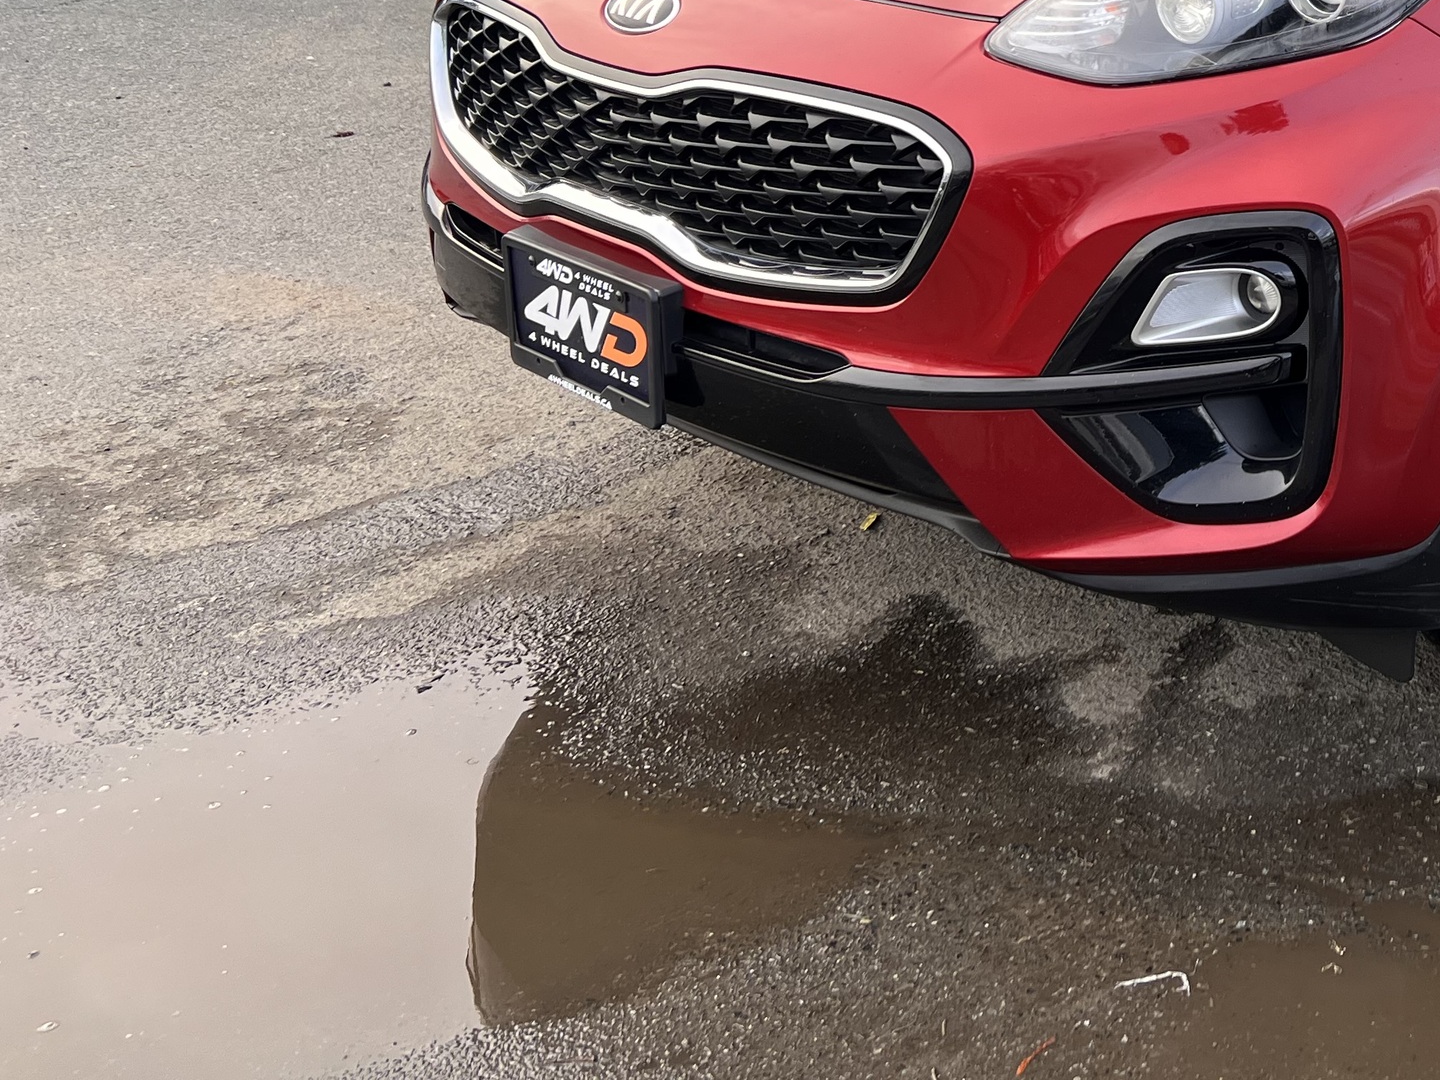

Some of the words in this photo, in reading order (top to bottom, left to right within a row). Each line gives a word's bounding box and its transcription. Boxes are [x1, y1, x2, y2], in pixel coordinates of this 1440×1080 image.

[536, 258, 573, 284] 4WD
[574, 271, 581, 280] 4
[583, 273, 614, 293] WHEEL
[579, 282, 611, 300] DEALS
[524, 285, 648, 368] 4WD
[528, 331, 537, 342] 4
[540, 335, 586, 363] WHEEL
[591, 358, 640, 388] DEALS
